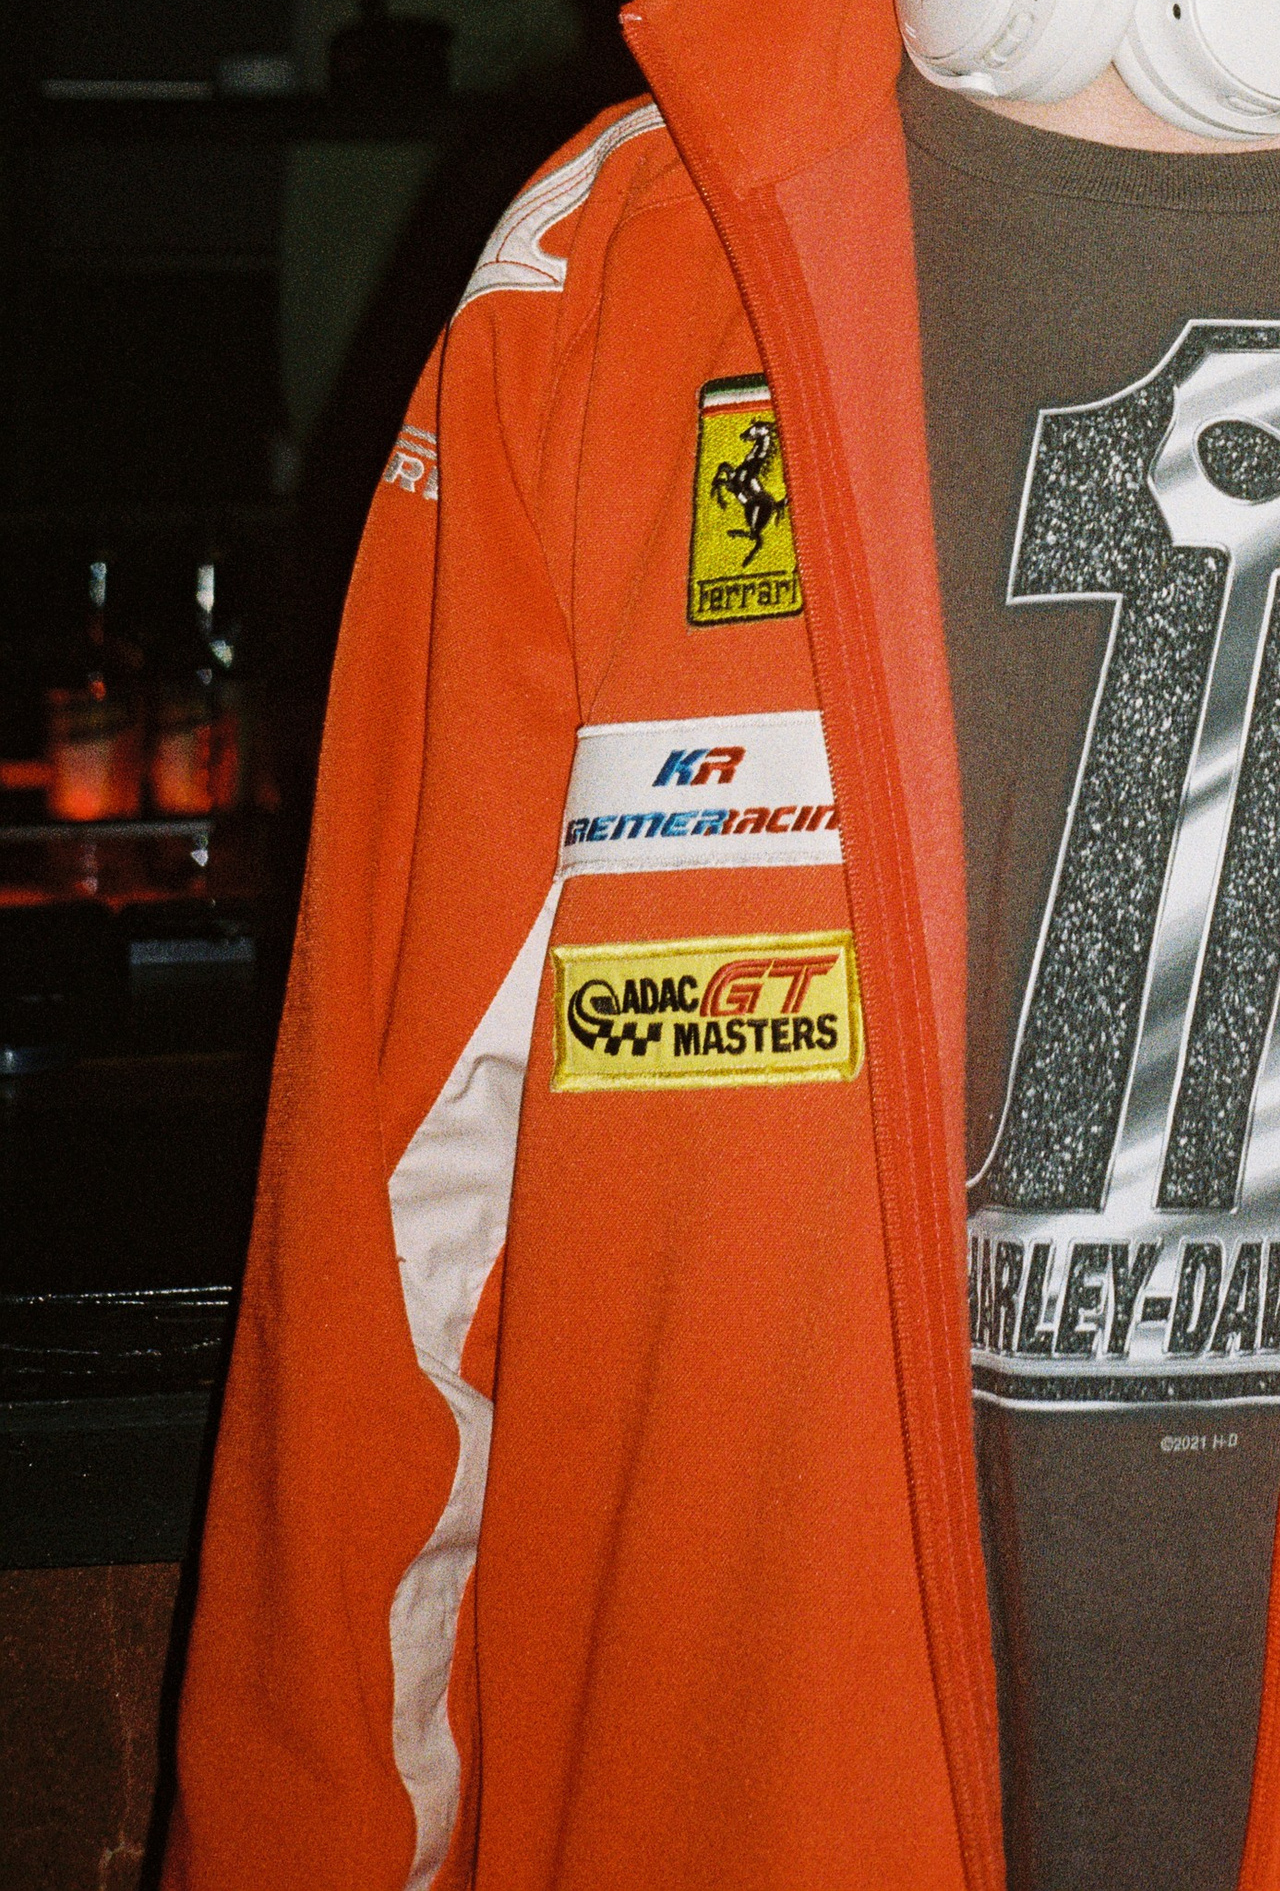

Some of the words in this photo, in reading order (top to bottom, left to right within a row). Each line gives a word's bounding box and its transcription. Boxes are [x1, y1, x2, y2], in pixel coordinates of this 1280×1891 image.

[652, 745, 747, 788] KR
[622, 974, 700, 1014] ADAC
[699, 953, 842, 1018] GT
[673, 1012, 839, 1057] MASTERS
